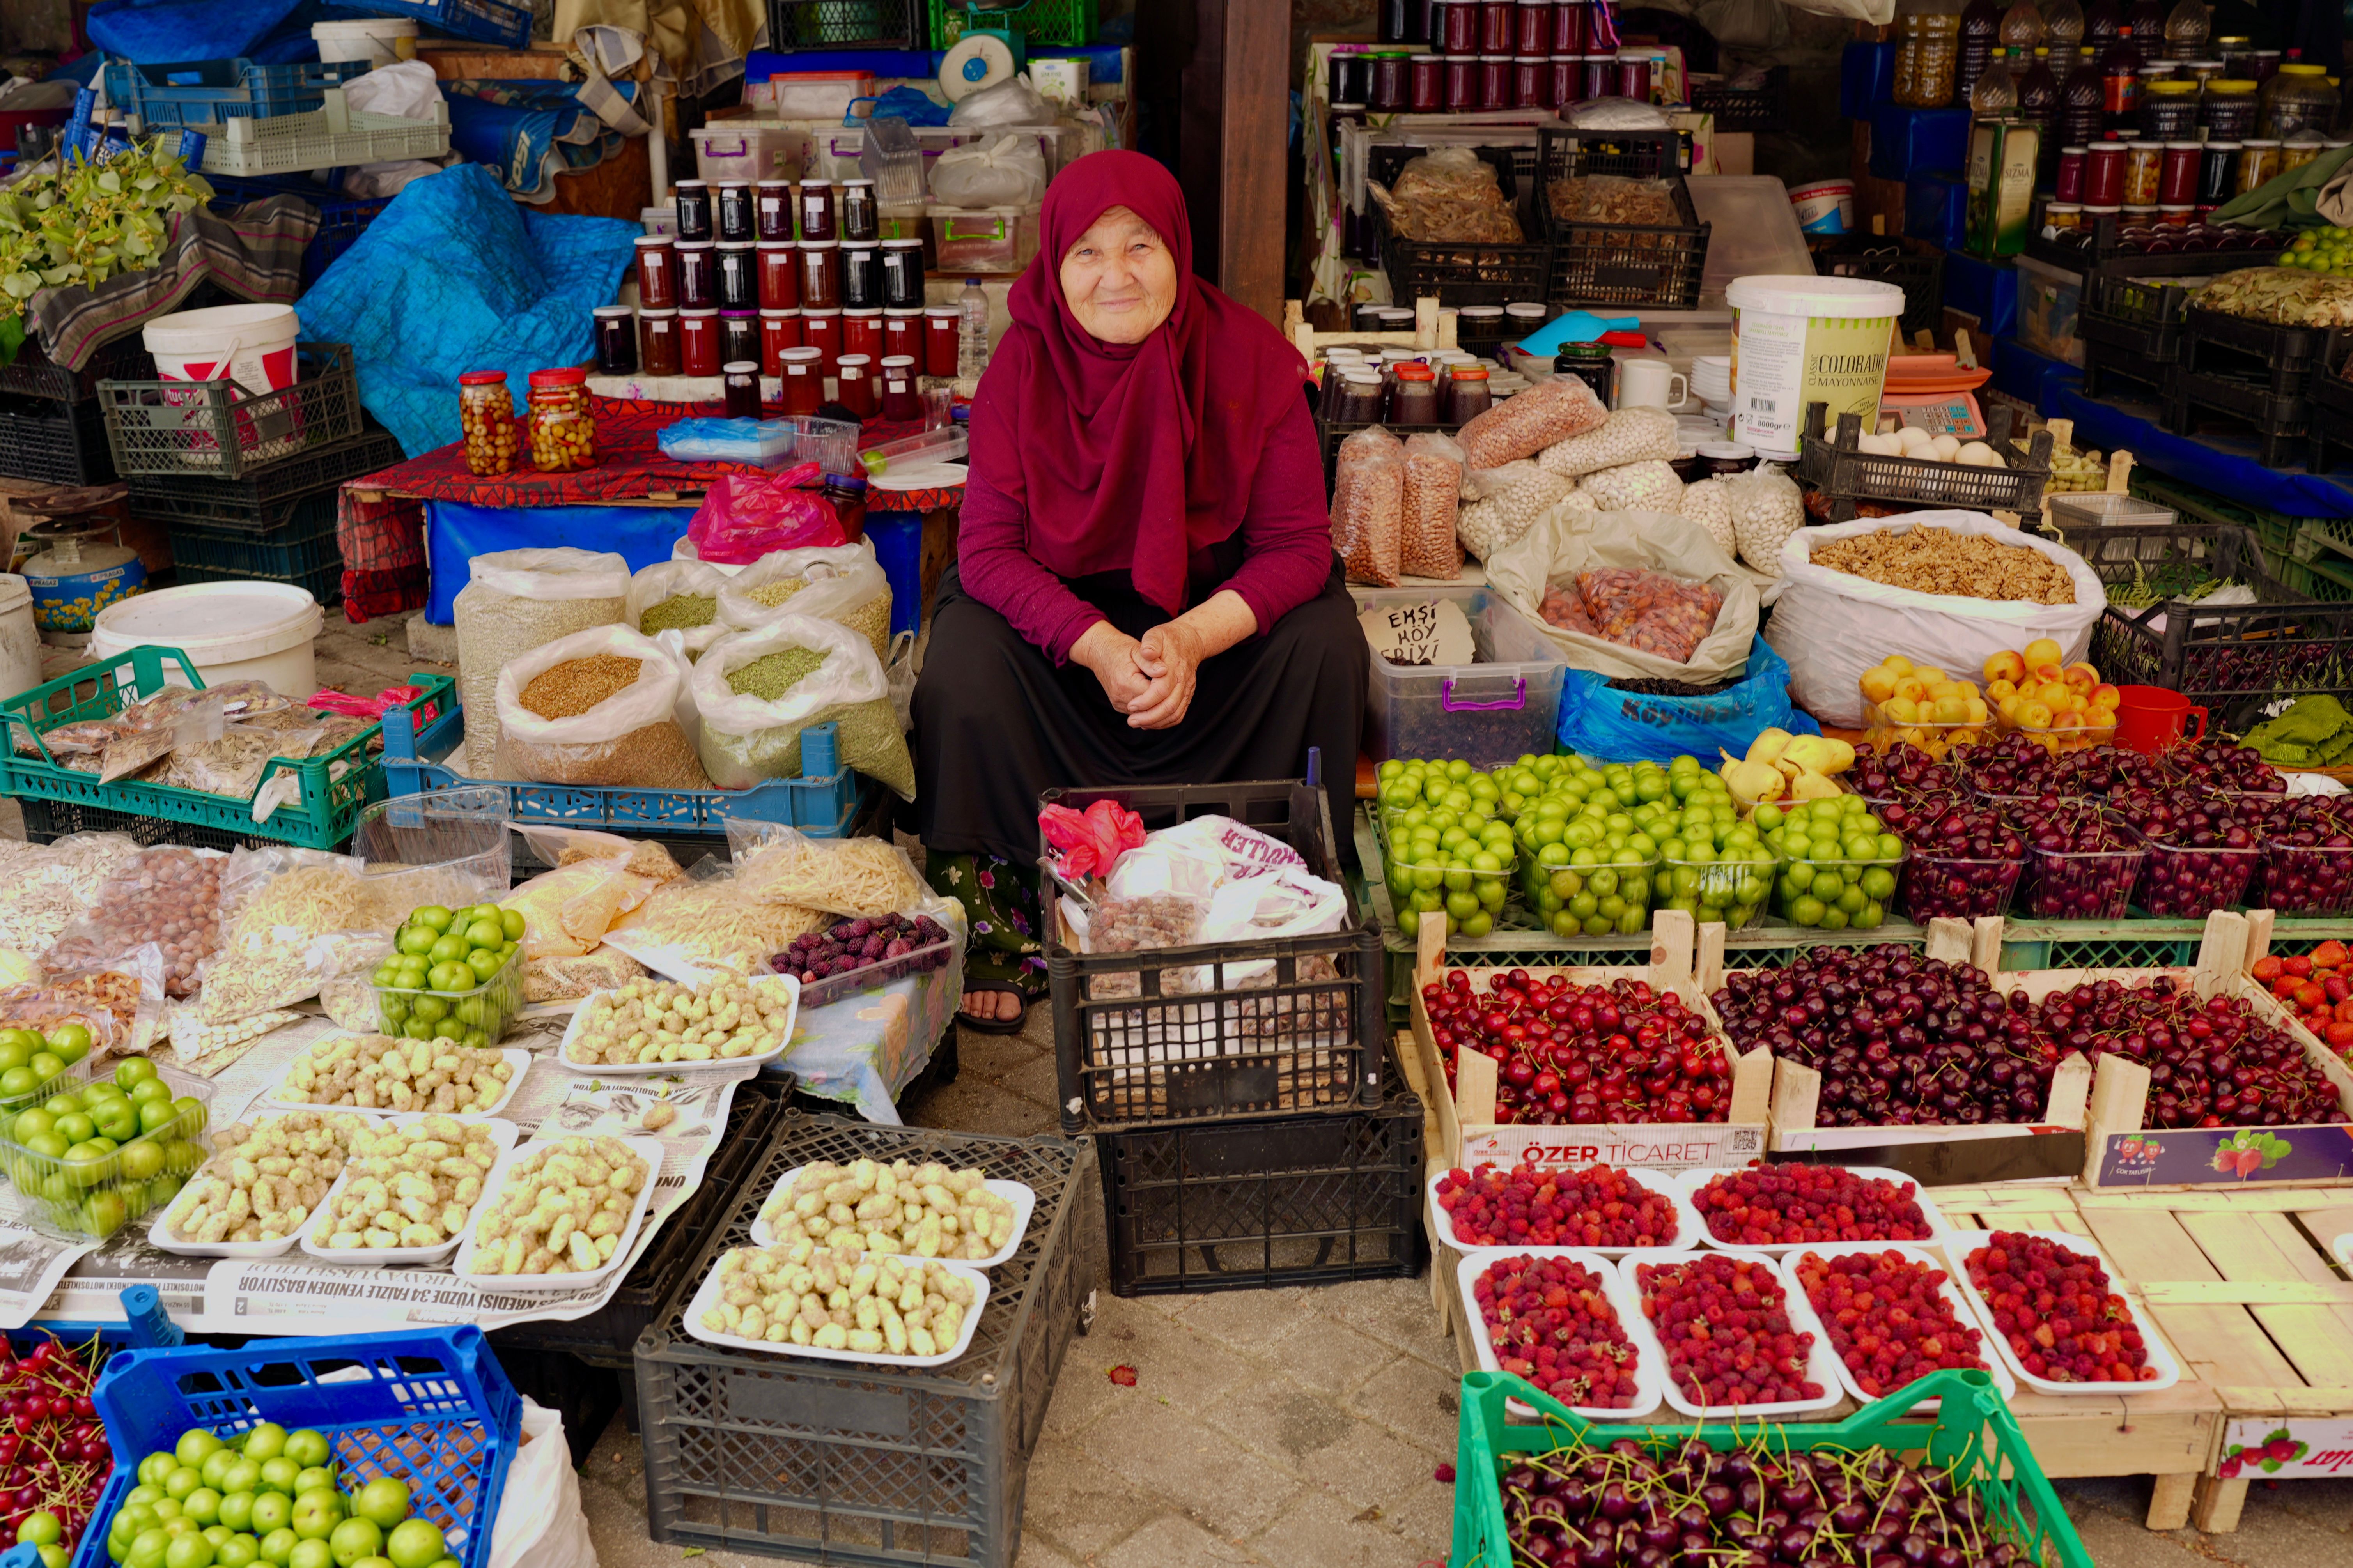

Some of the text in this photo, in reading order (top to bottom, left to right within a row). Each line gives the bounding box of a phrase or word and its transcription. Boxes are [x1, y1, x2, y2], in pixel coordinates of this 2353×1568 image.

[2005, 168, 2030, 178] SIZMA
[1752, 322, 1772, 330] COLORADO
[1809, 354, 1819, 386] CLASSIC
[1819, 353, 1884, 374] COLORADO
[1818, 376, 1879, 387] MAYONNAISE
[1758, 421, 1782, 430] 8000gr
[1522, 1140, 1717, 1163] ÖZER TİCARET
[238, 1276, 307, 1294] BAŞLIYOR
[307, 1281, 365, 1299] YENİDEN
[366, 1285, 411, 1302] FAİZLE
[412, 1288, 431, 1303] 34
[432, 1290, 475, 1308] YÜZDE
[477, 1294, 536, 1312] KREDİSİ
[237, 1301, 245, 1313] 2
